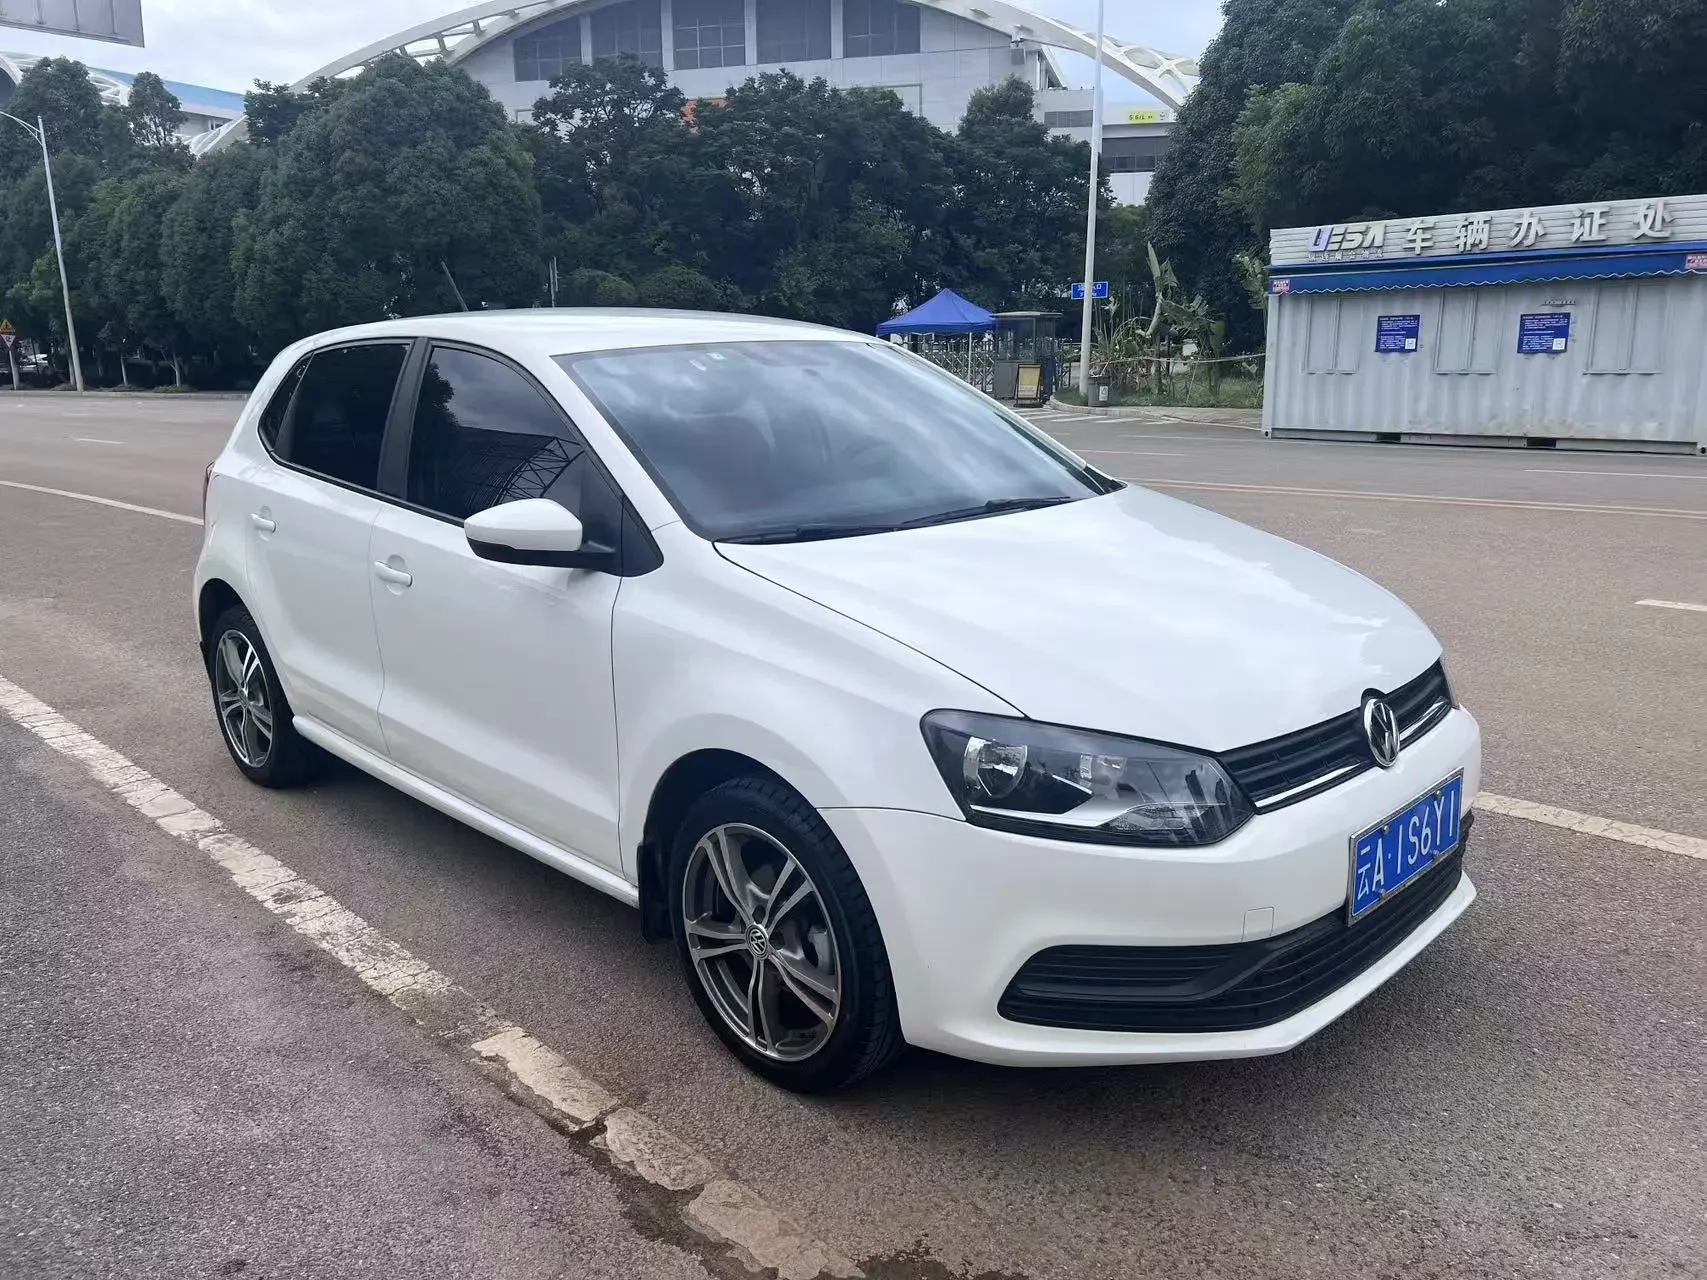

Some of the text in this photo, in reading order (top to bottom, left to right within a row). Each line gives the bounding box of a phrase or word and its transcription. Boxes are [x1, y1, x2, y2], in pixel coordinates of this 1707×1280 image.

[1402, 201, 1675, 255] 车辆办证处
